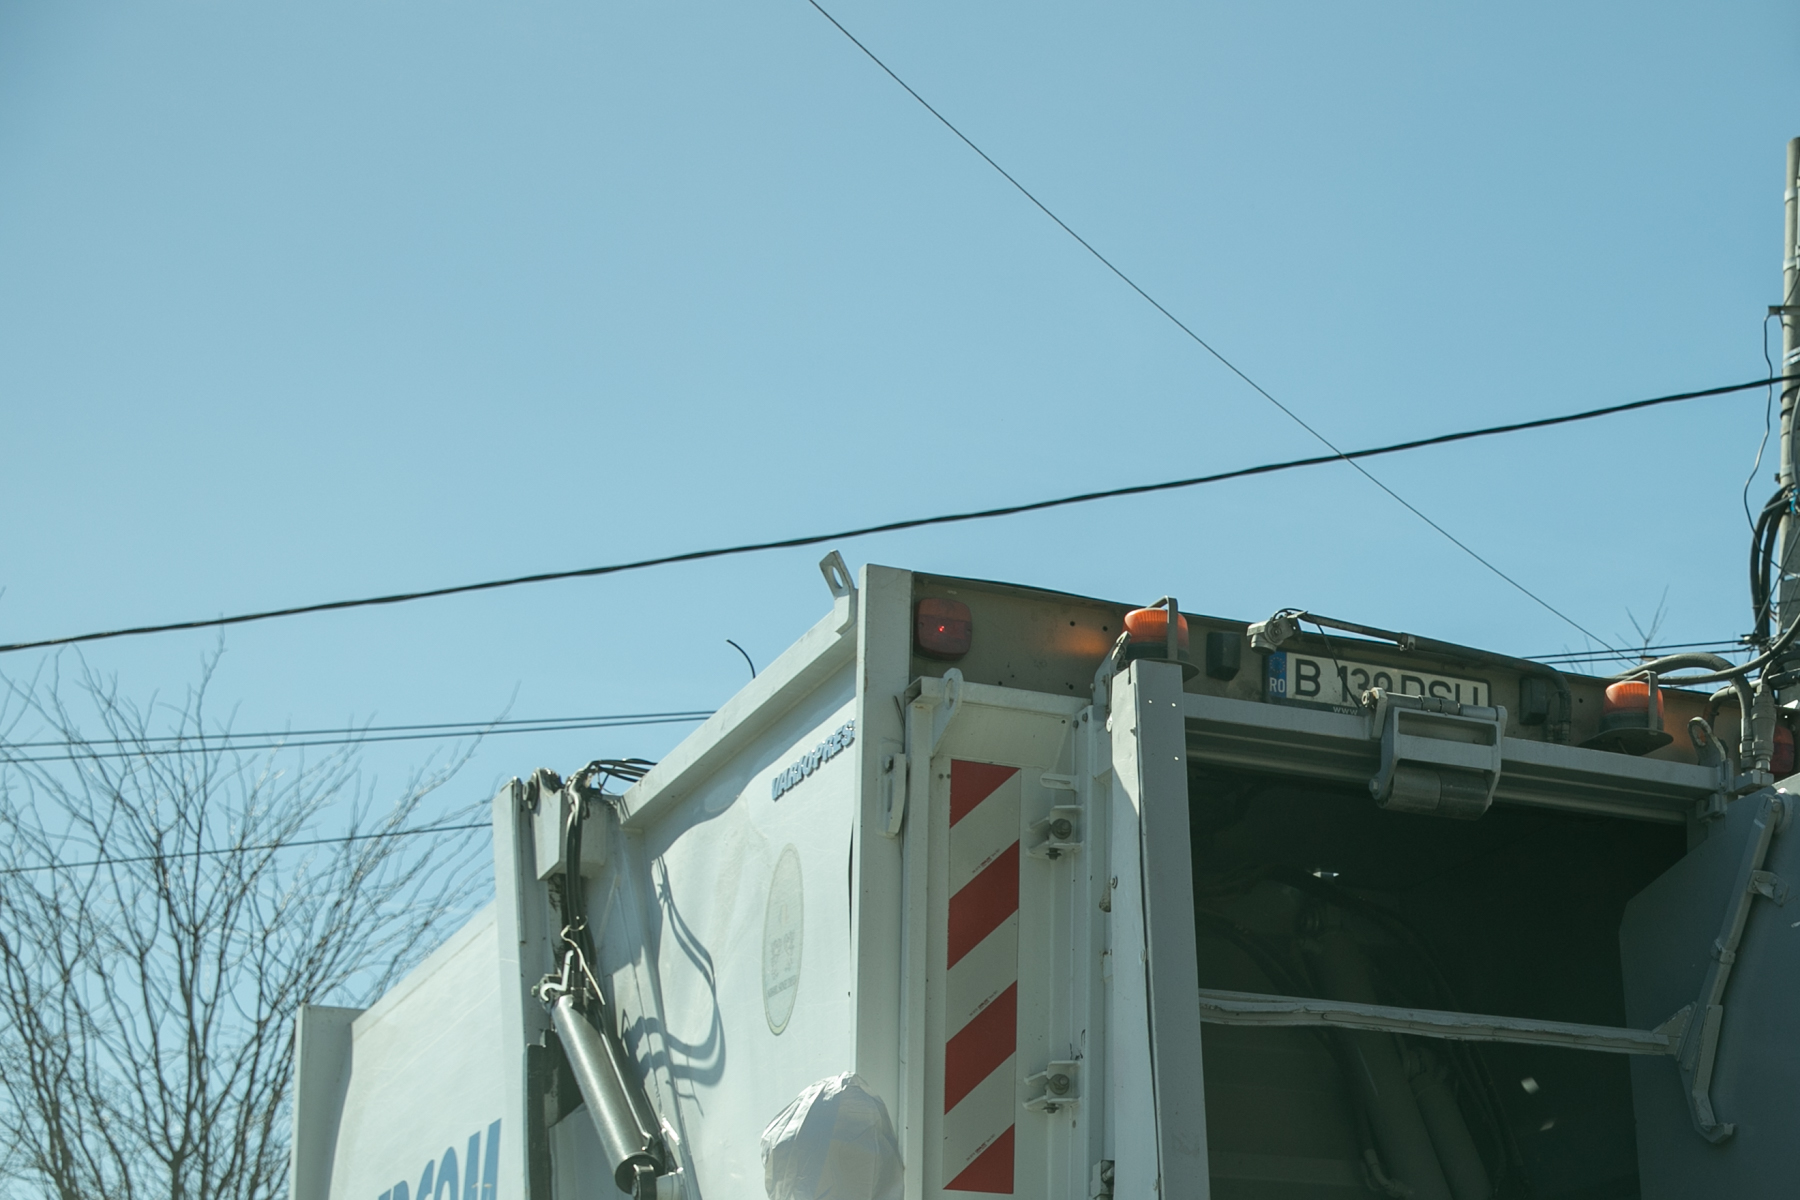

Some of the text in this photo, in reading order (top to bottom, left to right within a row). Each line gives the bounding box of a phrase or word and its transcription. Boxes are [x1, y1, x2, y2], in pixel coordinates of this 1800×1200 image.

[1269, 677, 1286, 693] RO
[1295, 658, 1321, 697] B
[1401, 674, 1479, 705] DSU
